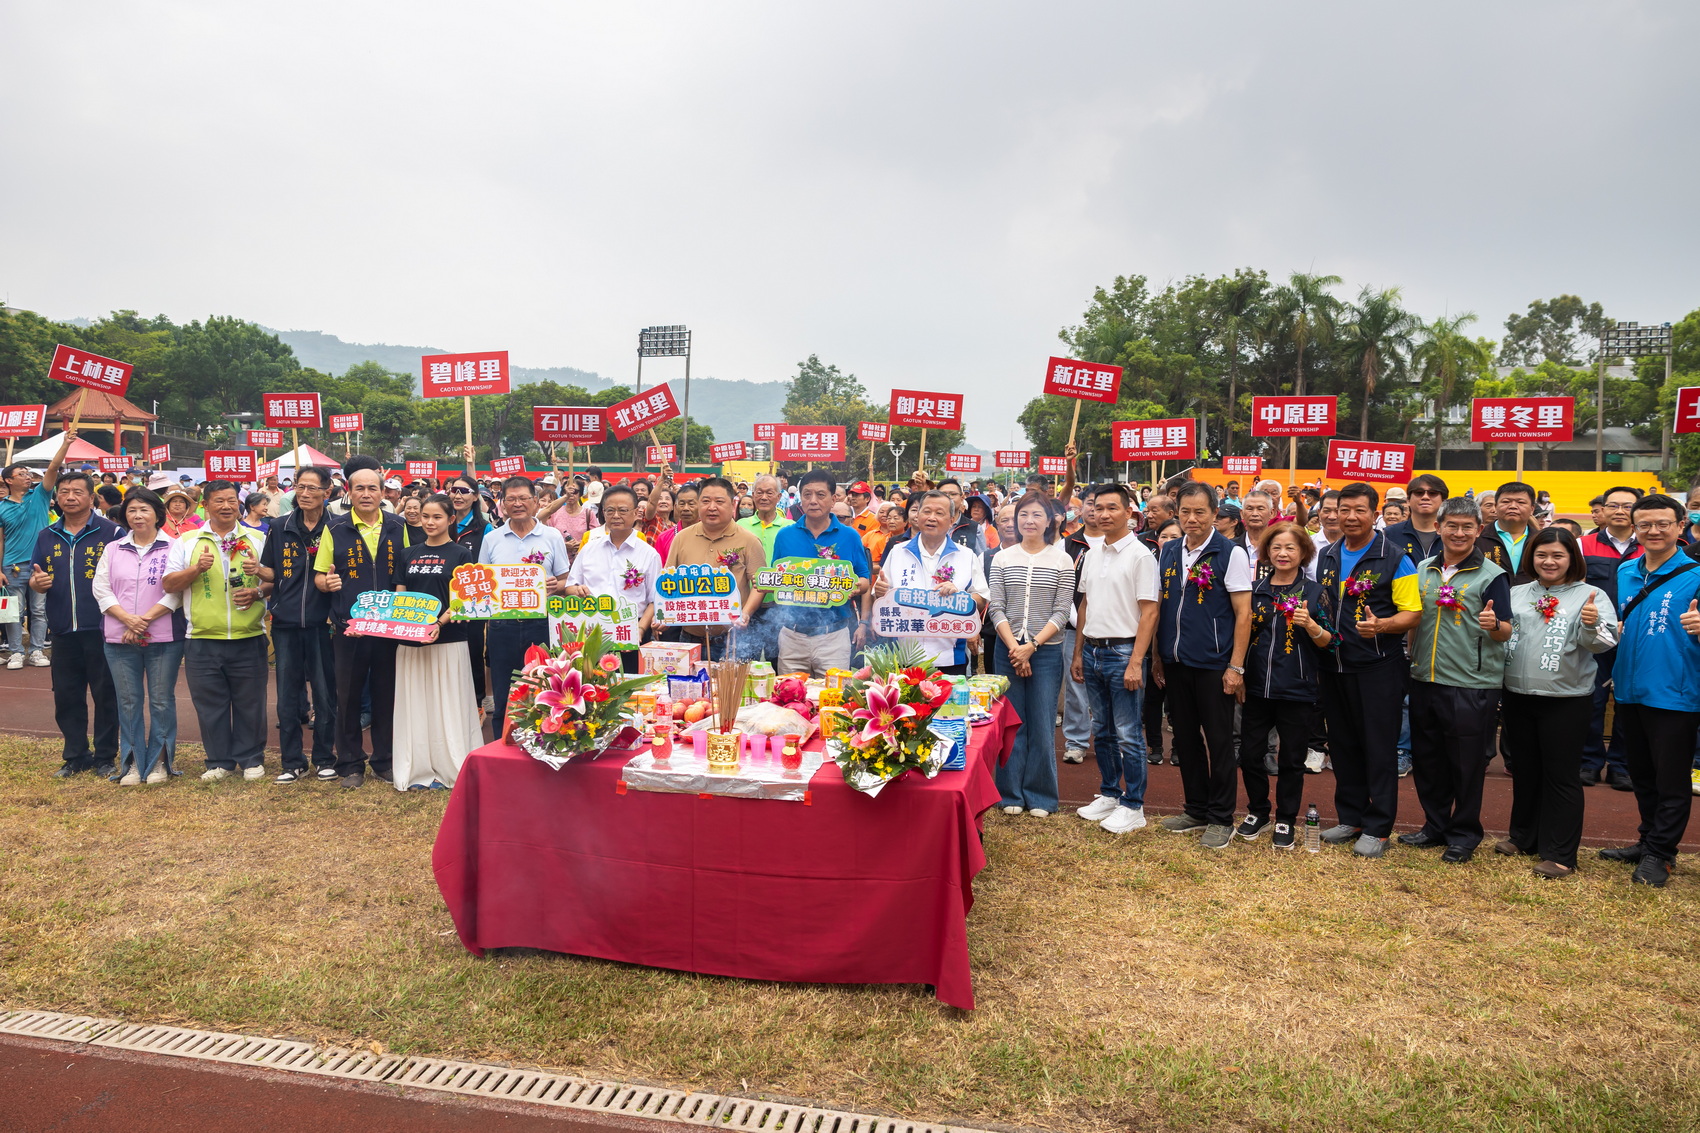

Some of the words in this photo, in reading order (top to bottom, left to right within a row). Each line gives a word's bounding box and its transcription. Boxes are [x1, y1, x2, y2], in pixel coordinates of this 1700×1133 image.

[59, 354, 124, 386] 上林里
[430, 359, 501, 384] 碧峰里
[1052, 364, 1115, 392] 新庄里
[65, 374, 86, 384] CAOTUN
[86, 380, 112, 390] TOWNSHIP
[1079, 390, 1103, 398] TOWNSHIP
[269, 400, 315, 417] 新厝里
[614, 391, 670, 428] 北投里
[1260, 404, 1328, 424] 中原里
[1481, 405, 1563, 428] 雙冬里
[541, 414, 600, 431] 石川里
[627, 423, 644, 433] CAOTUN
[645, 413, 667, 426] TOWNSHIP
[780, 432, 838, 450] 加老里
[1120, 426, 1187, 449] 新豐里
[209, 456, 251, 473] 復興里
[1336, 447, 1405, 472] 平林里
[84, 546, 95, 579] 馬文君
[457, 568, 486, 585] 活力
[501, 568, 539, 578] 歡迎大家
[759, 572, 805, 588] 優化草屯
[807, 575, 854, 590] 爭取升市
[463, 581, 492, 597] 草屯
[506, 578, 534, 588] 一起來
[661, 576, 731, 595] 中山公園
[358, 592, 391, 609] 草屯
[392, 595, 440, 611] 運動休閒
[502, 590, 539, 609] 運動
[550, 597, 613, 613] 中山公園
[665, 600, 730, 611] 設施改善工程
[899, 589, 970, 612] 南投縣政府
[391, 608, 427, 623] 好地方
[676, 611, 720, 623] 竣工典禮
[880, 607, 901, 617] 縣長
[1656, 591, 1673, 633] 南投縣政府
[880, 619, 925, 633] 許淑華
[929, 622, 974, 631] 補助經費
[1539, 617, 1568, 672] 洪巧娟
